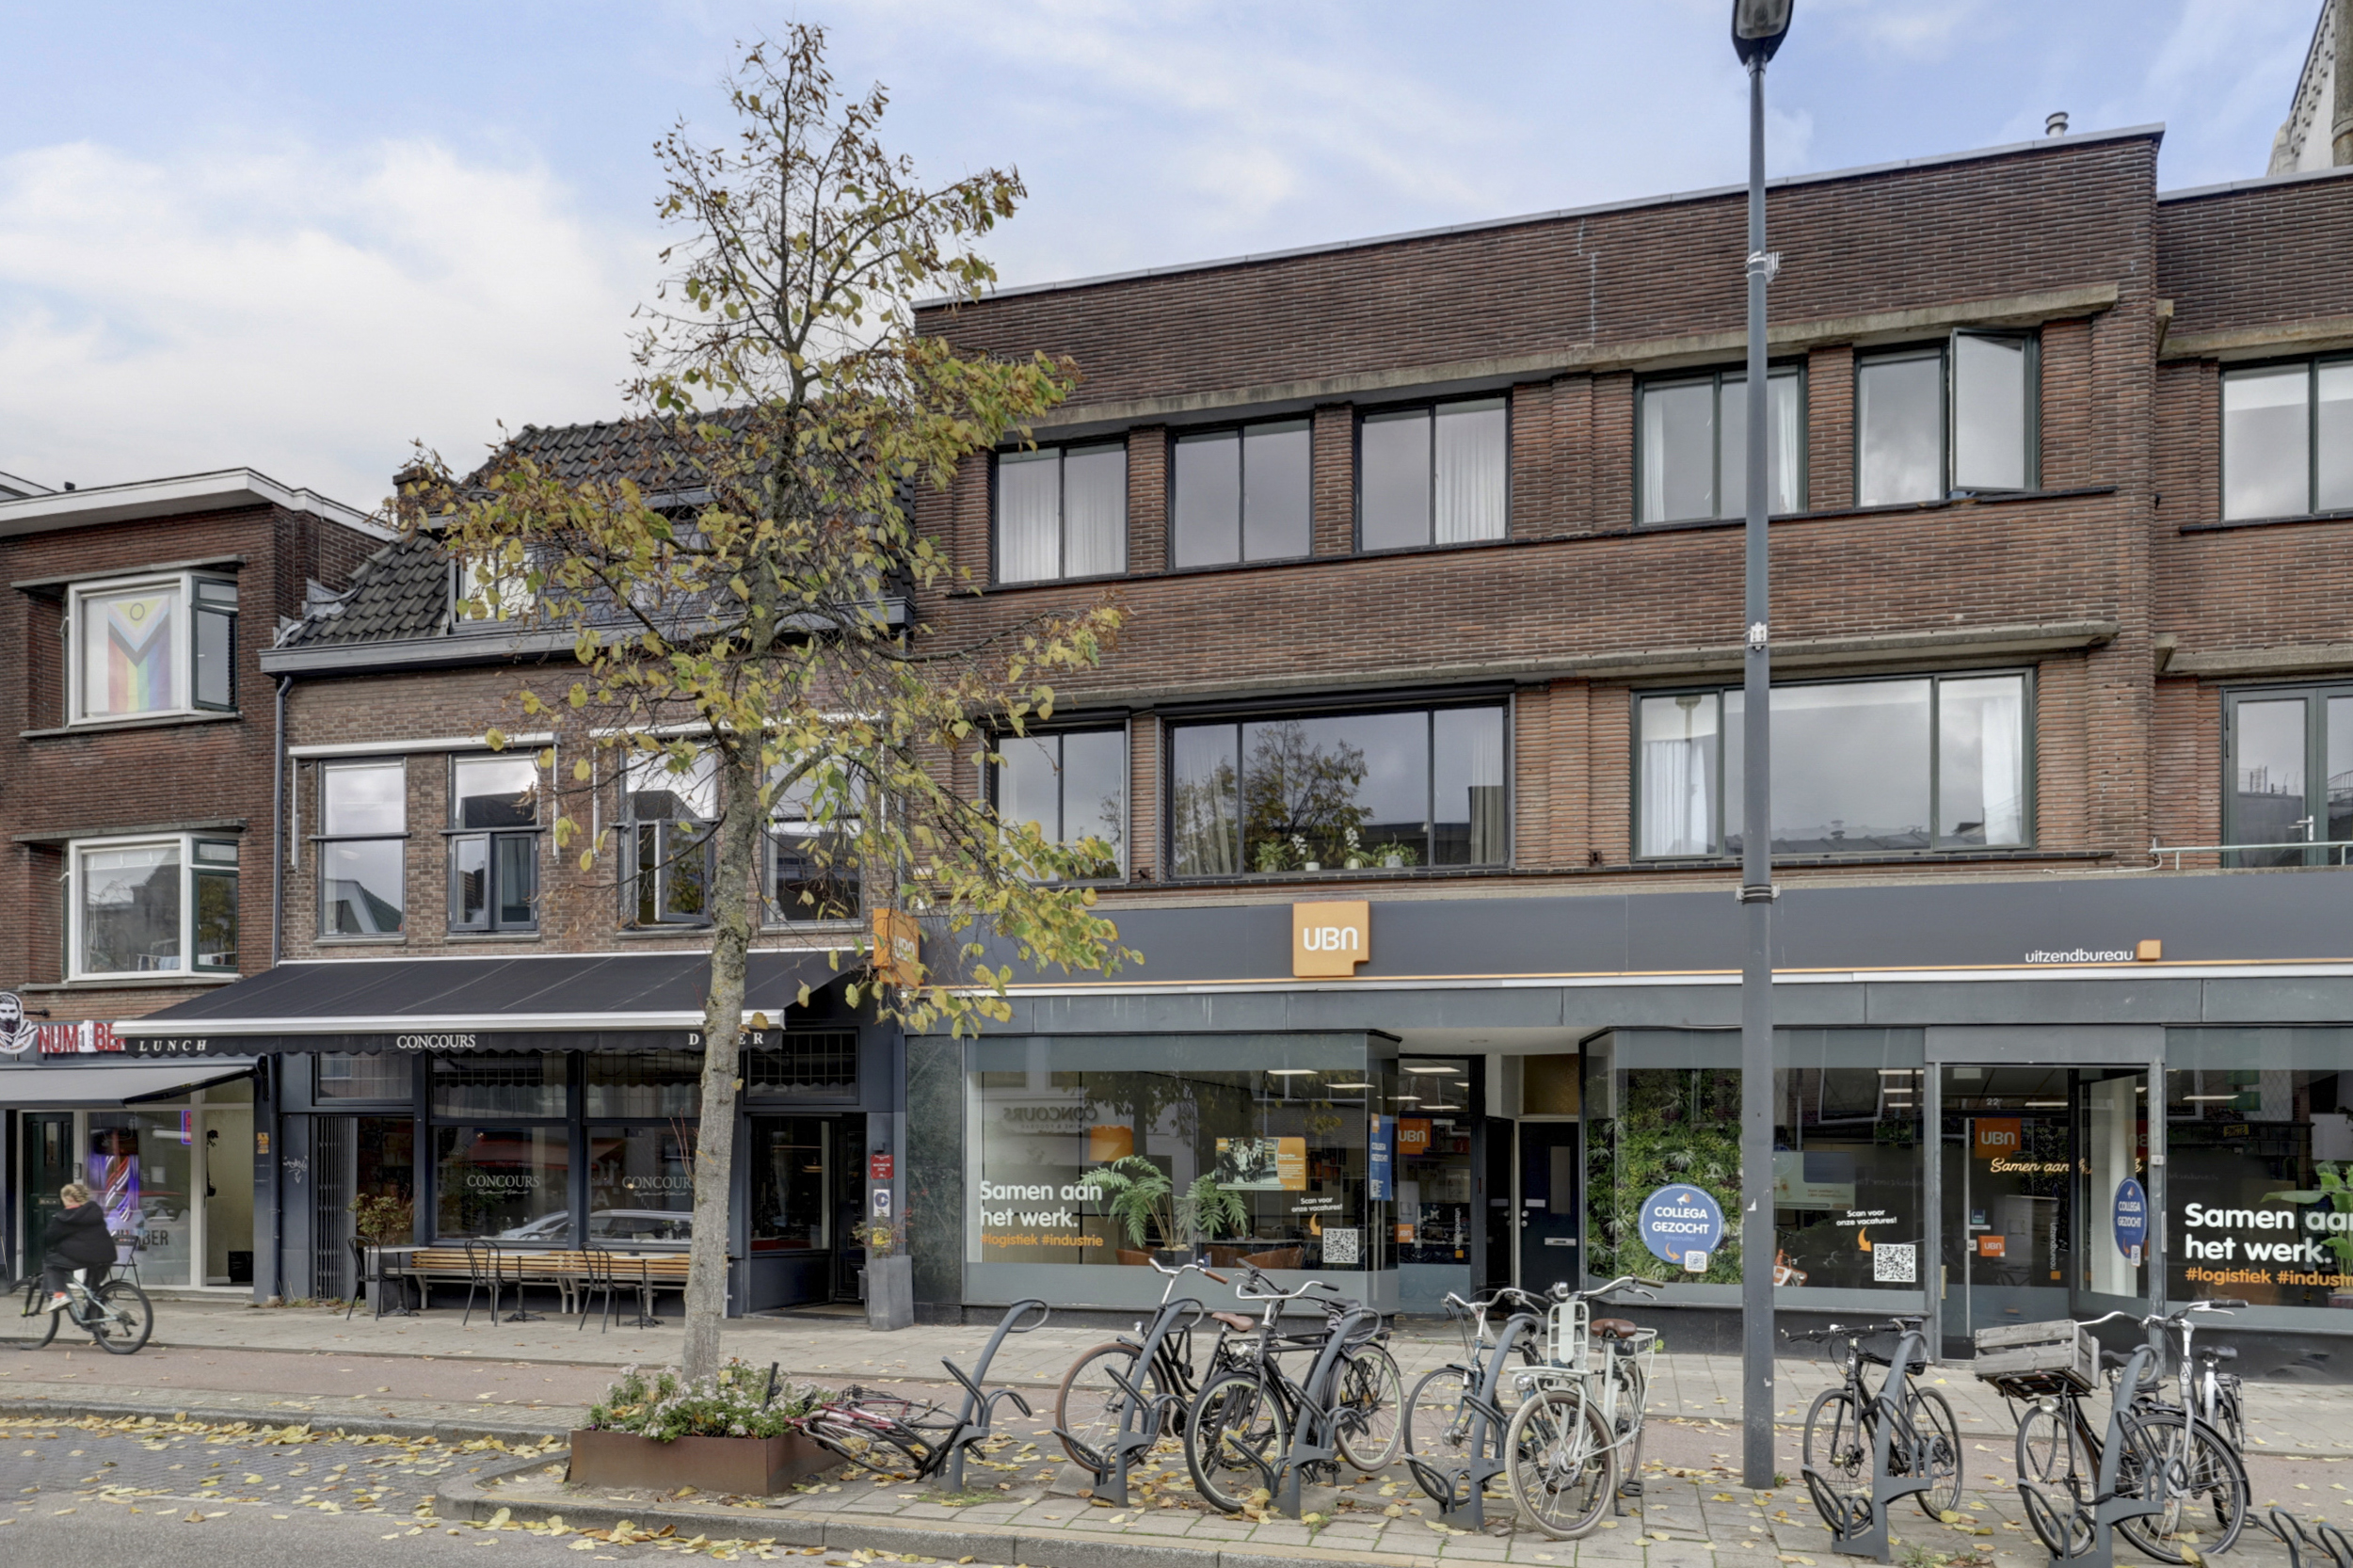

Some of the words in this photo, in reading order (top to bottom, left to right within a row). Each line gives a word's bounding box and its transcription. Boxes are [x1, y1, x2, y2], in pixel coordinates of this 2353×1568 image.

[1303, 926, 1359, 952] UBN
[2025, 947, 2134, 964] uitzendbureau
[138, 1039, 207, 1052] LUNCH
[396, 1033, 476, 1049] CONCOURS
[688, 1032, 764, 1046] DER
[1399, 1129, 1427, 1143] UBN
[1980, 1131, 2016, 1145] UBN
[1990, 1157, 2041, 1173] Samen
[2043, 1162, 2071, 1173] aan
[467, 1175, 540, 1188] CONCOURS
[980, 1179, 1054, 1201] Samen
[1060, 1185, 1103, 1201] aan
[1308, 1203, 1343, 1212] vacatures!
[1654, 1206, 1708, 1220] COLLEGA
[1846, 1209, 1866, 1218] Scan
[980, 1206, 1015, 1227] het
[1019, 1206, 1079, 1228] werk.
[1857, 1216, 1897, 1225] vacatures!
[2185, 1202, 2295, 1229] Samen
[2305, 1210, 2353, 1231] aa
[1652, 1221, 1710, 1235] GEZOCHT
[980, 1233, 1038, 1248] #logistiek
[1041, 1234, 1104, 1247] #industrie
[2185, 1233, 2236, 1260] het
[2244, 1237, 2332, 1264] werk.
[2185, 1267, 2272, 1286] #logistiek
[2277, 1270, 2353, 1288] #industr
